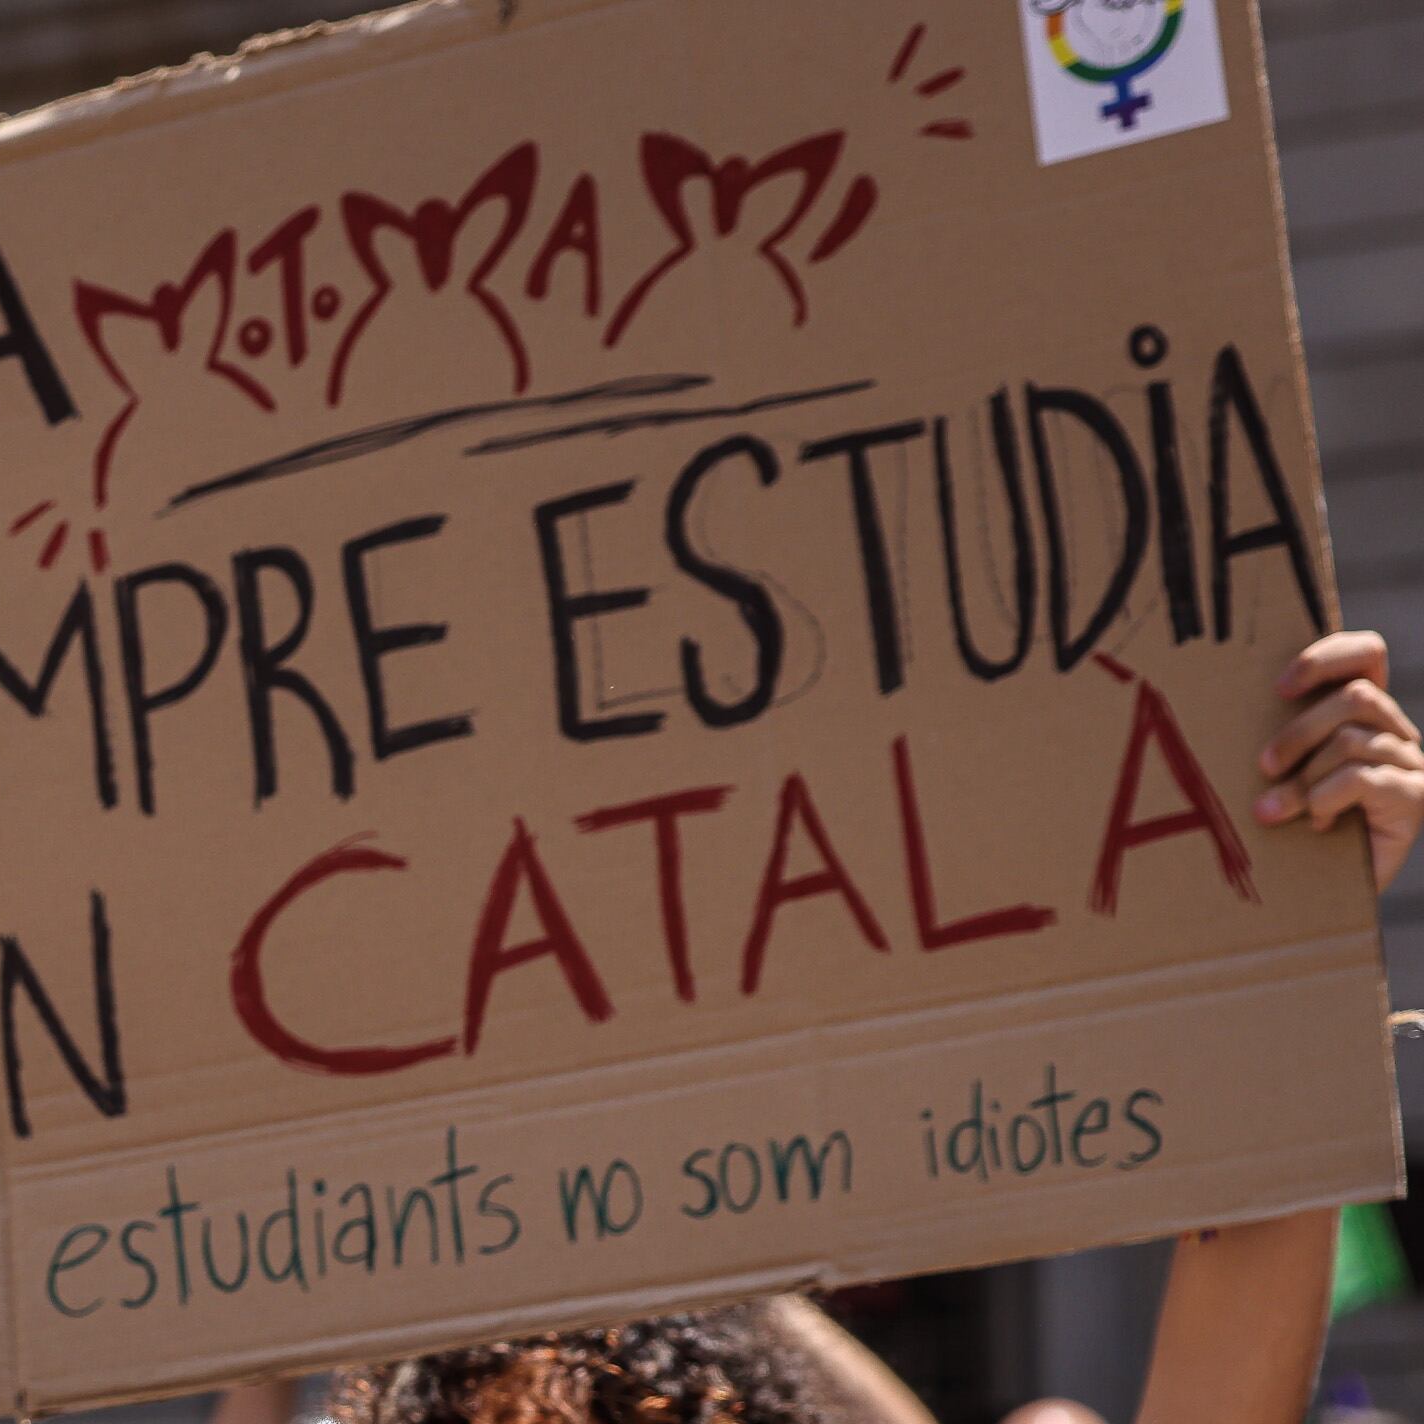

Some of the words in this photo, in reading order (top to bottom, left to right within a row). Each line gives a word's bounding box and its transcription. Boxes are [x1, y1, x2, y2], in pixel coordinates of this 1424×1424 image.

[230, 650, 1262, 1076] CATALÀ
[41, 1126, 522, 1318] estudiants
[556, 1151, 646, 1245] no
[677, 1126, 855, 1219] som
[919, 1062, 1167, 1185] idiotes
